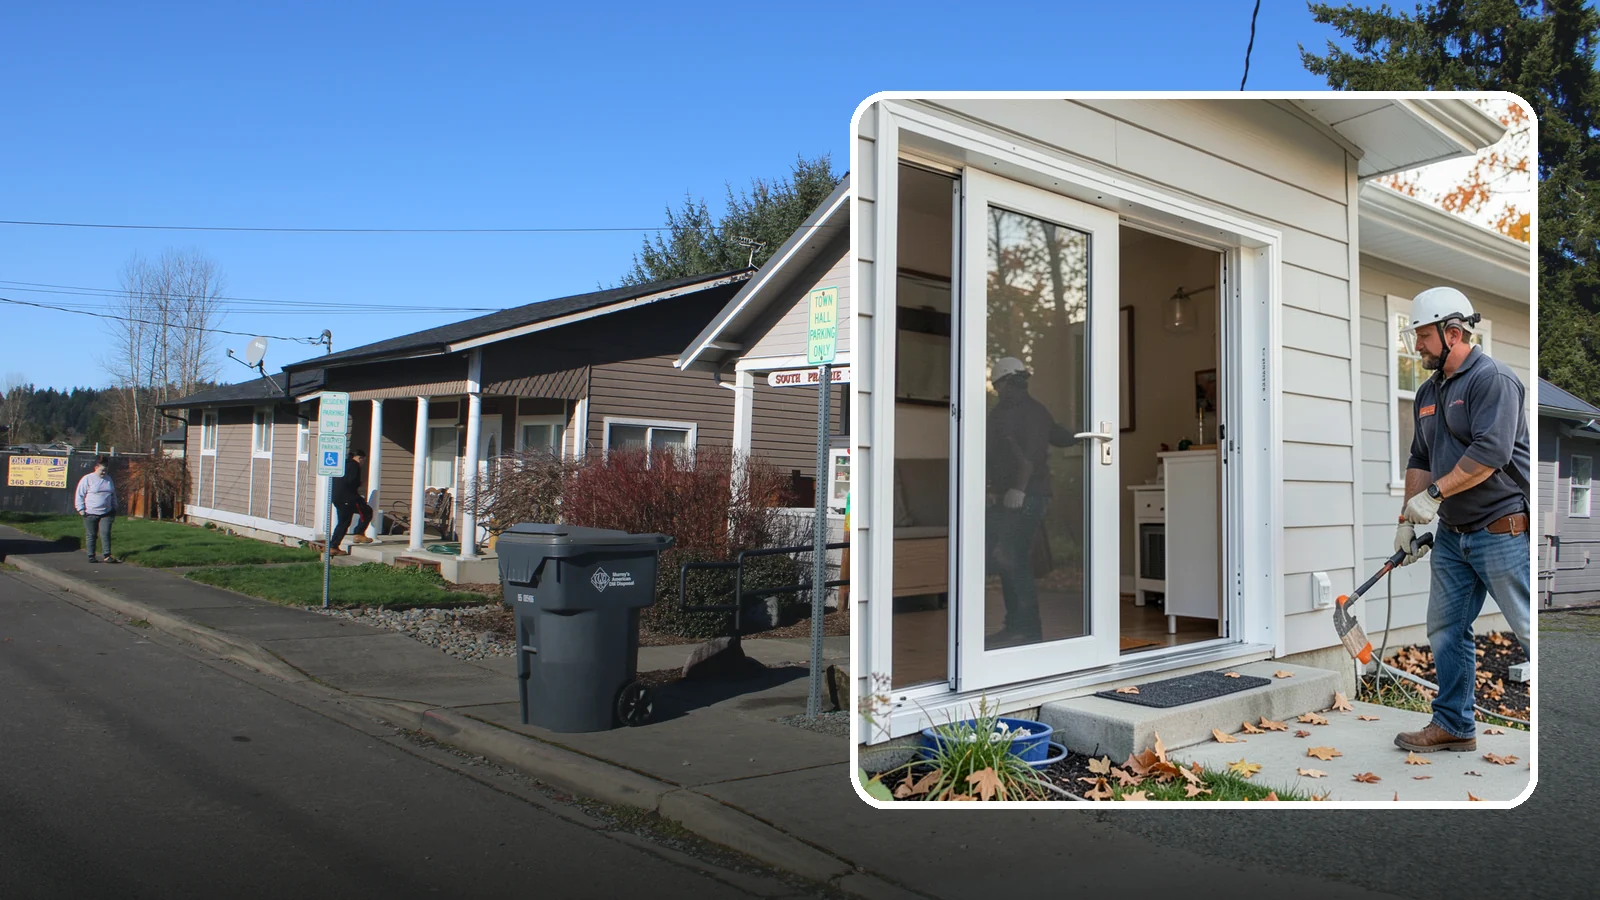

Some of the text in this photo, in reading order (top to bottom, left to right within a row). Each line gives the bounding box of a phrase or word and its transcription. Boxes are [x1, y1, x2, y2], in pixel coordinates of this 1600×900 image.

[815, 294, 833, 308] TOWN
[814, 312, 831, 324] HALL
[810, 327, 835, 340] PARKING
[814, 344, 830, 357] ONLY
[775, 373, 801, 384] SOUTH
